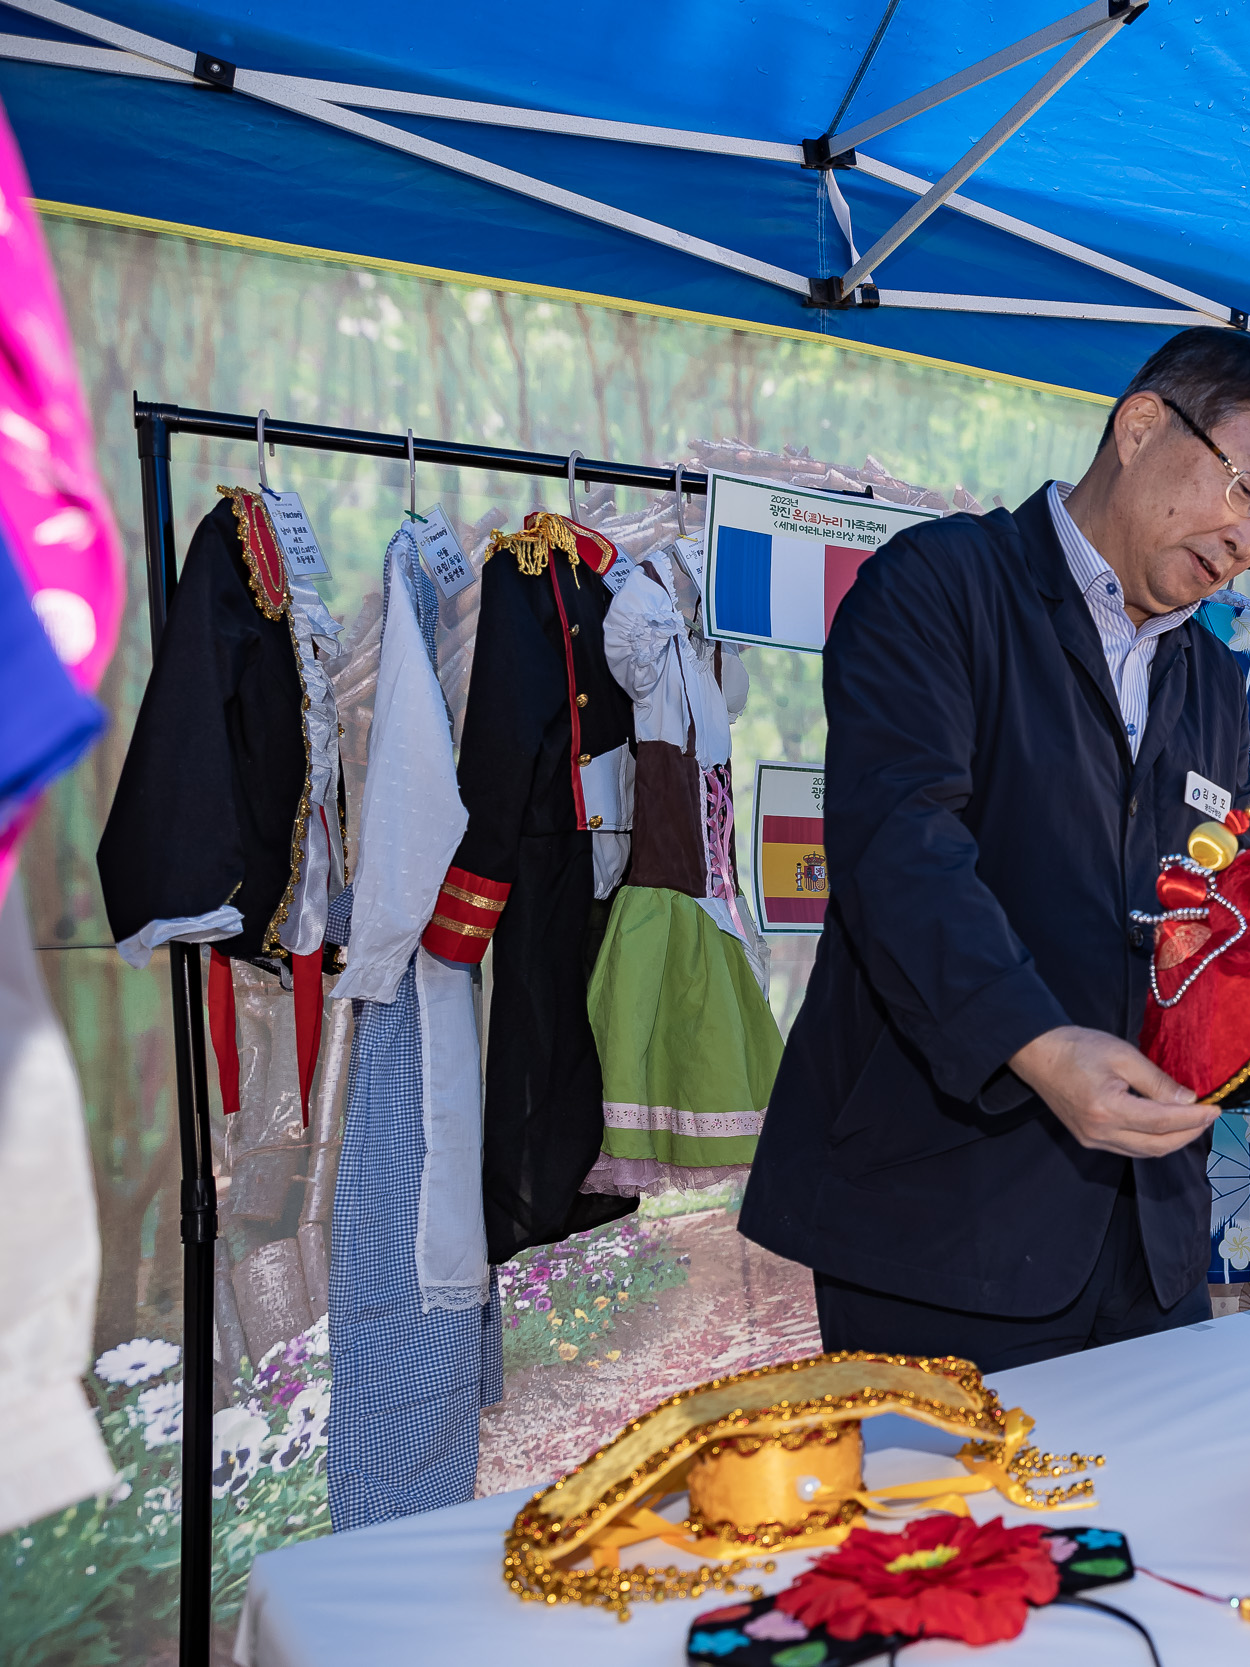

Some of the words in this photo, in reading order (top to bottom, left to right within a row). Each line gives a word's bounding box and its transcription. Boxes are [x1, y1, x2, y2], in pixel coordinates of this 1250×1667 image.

[770, 494, 799, 508] 2023년
[769, 504, 791, 519] 광진
[844, 518, 887, 535] 가족축제
[443, 565, 465, 584] 초등생용
